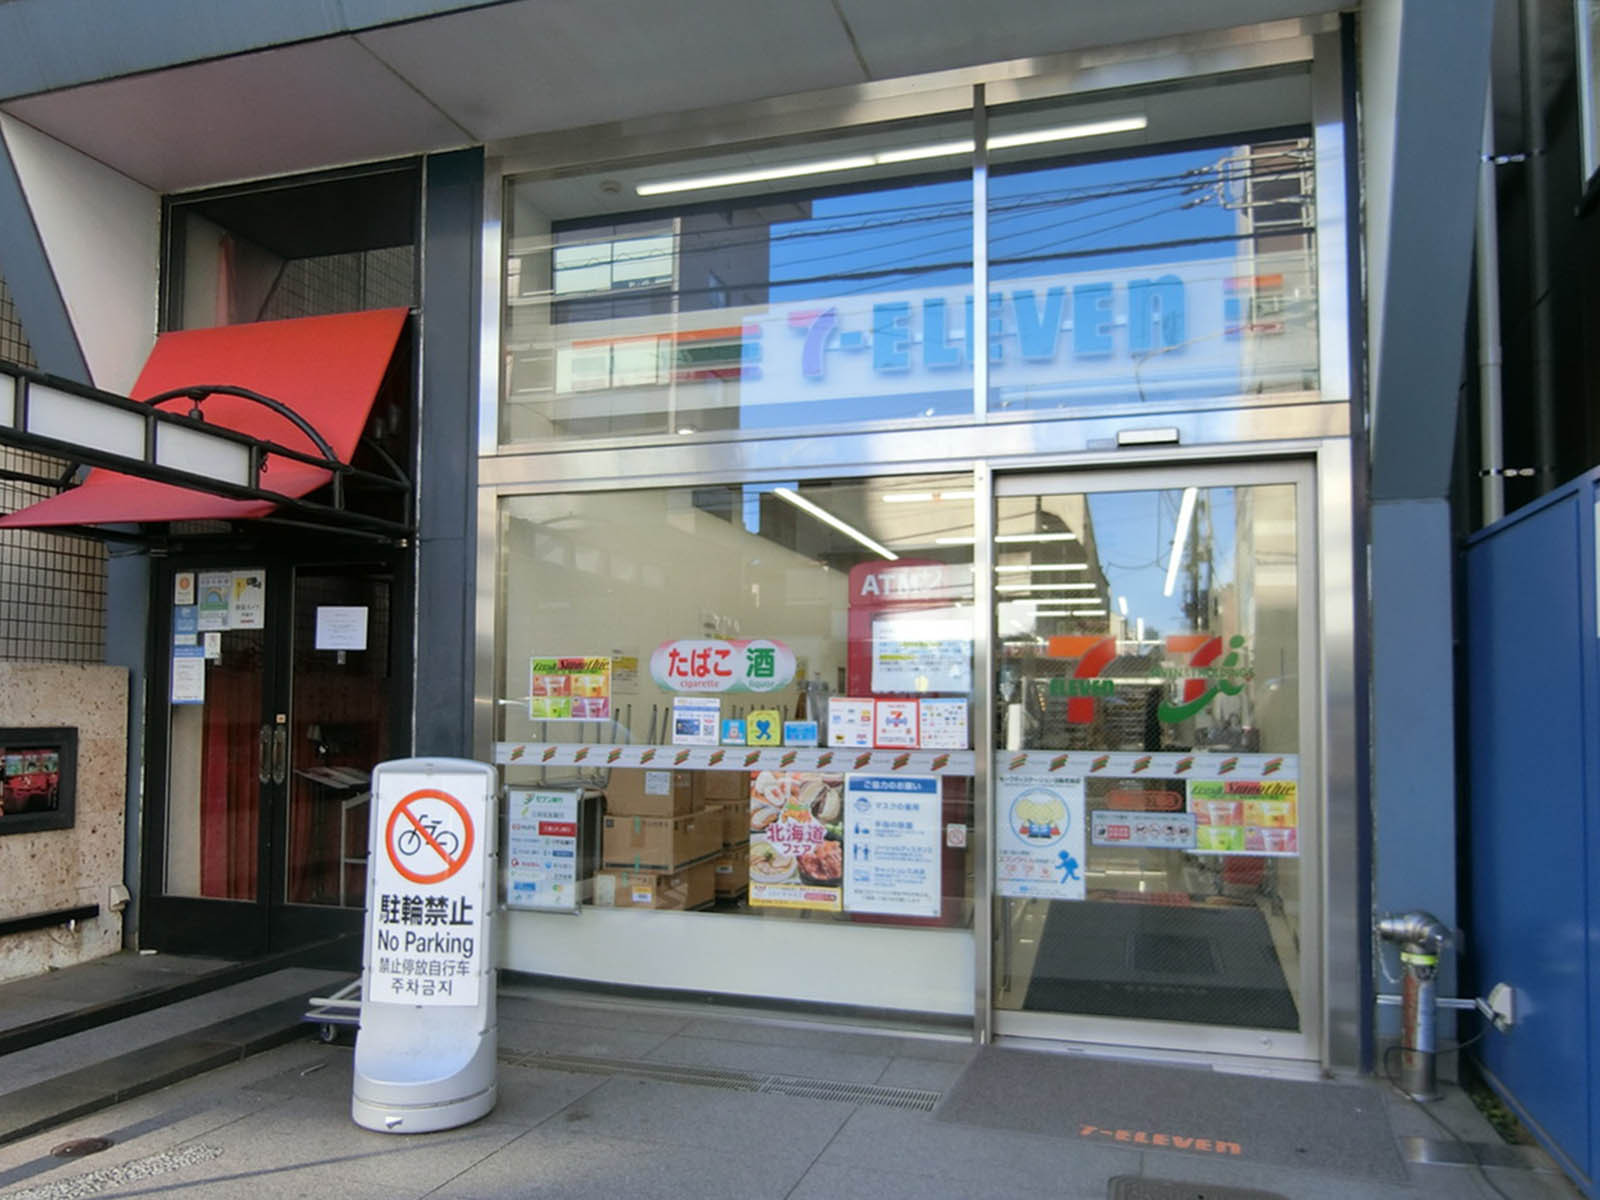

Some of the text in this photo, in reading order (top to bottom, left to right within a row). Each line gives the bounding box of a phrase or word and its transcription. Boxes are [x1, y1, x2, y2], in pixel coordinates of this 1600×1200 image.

[668, 646, 776, 678] たばこ 酒
[767, 824, 826, 844] 北海道
[782, 843, 812, 855] フェア
[380, 894, 473, 926] 駐輪禁止
[377, 929, 475, 958] No Parking
[379, 957, 470, 977] 禁止停放自行车
[391, 977, 453, 996] 주차금지
